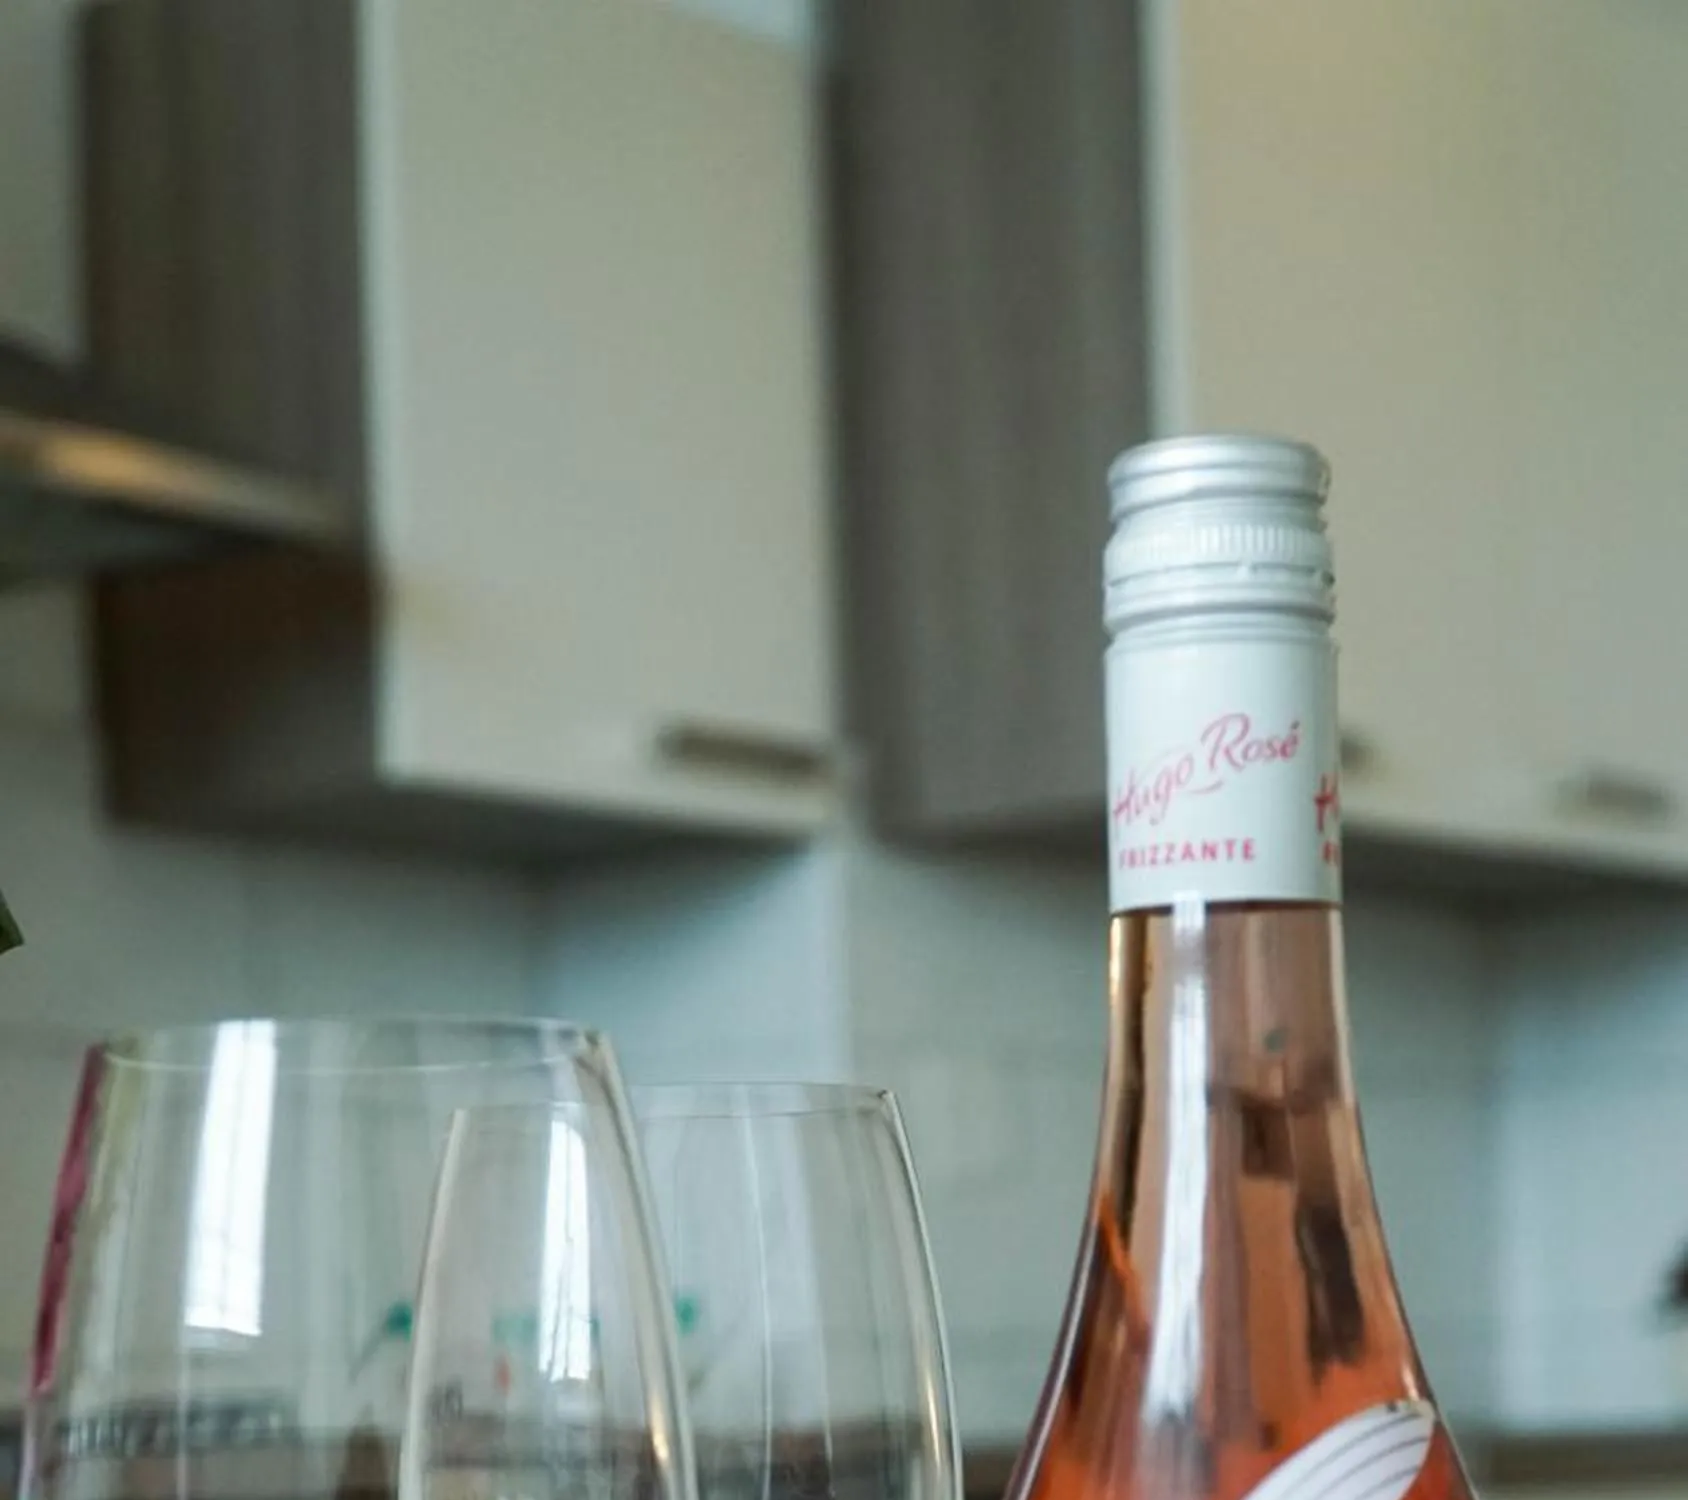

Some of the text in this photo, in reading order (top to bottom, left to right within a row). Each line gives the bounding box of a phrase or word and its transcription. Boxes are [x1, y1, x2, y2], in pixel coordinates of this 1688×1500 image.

[1113, 712, 1300, 830] Hugo Rosé
[1118, 837, 1255, 869] FRIZZANTE
